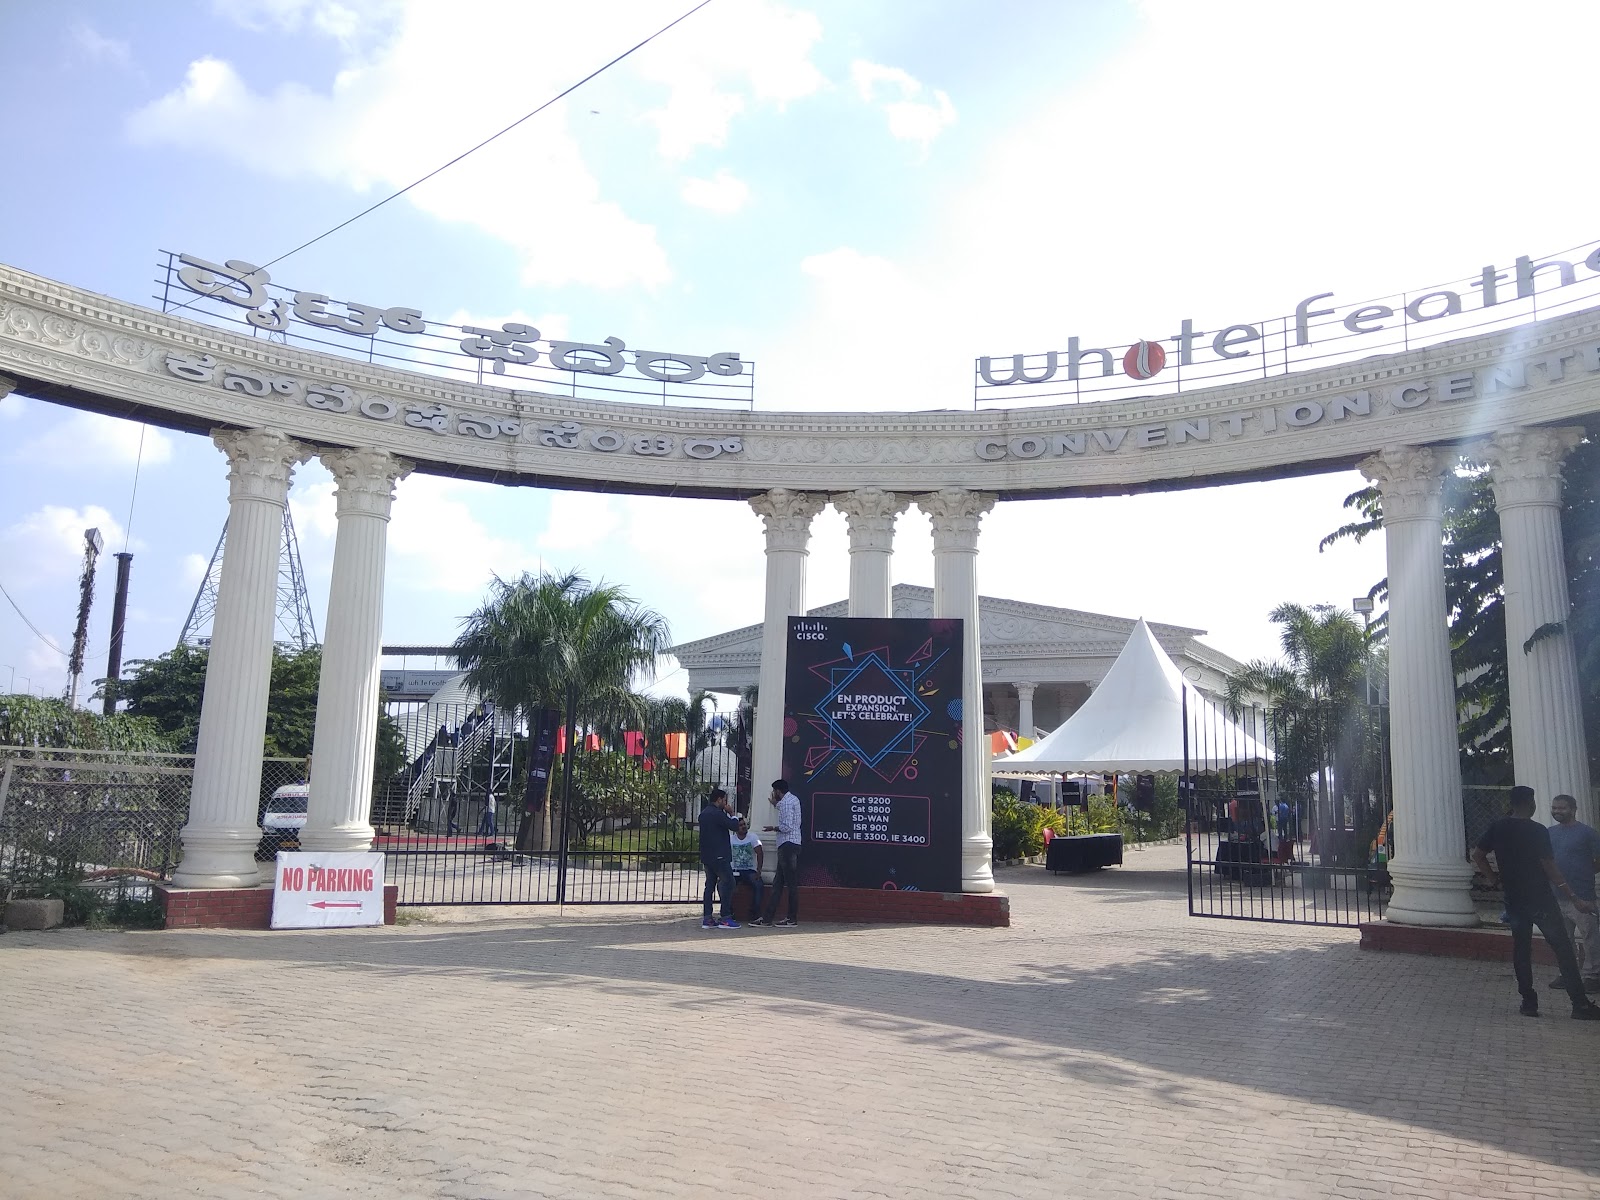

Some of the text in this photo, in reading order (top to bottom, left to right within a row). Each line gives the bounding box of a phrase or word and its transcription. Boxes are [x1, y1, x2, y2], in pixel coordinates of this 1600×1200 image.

[1296, 247, 1600, 346] feath
[975, 390, 1371, 461] CONVENTION
[837, 695, 907, 705] EN PRODUCT
[846, 704, 899, 713] EXPANSION.
[832, 711, 913, 722] LET'S CELEBRATE!
[851, 796, 891, 805] Cat 9200
[851, 805, 891, 814] Cat 9800
[852, 815, 889, 823] SD-WAN
[870, 824, 888, 832] 900
[815, 831, 824, 839] IE
[826, 832, 851, 840] 3200,
[864, 833, 889, 842] 3300,
[891, 834, 900, 842] IE
[902, 835, 926, 844] 3400
[282, 867, 374, 892] NO PARKING
